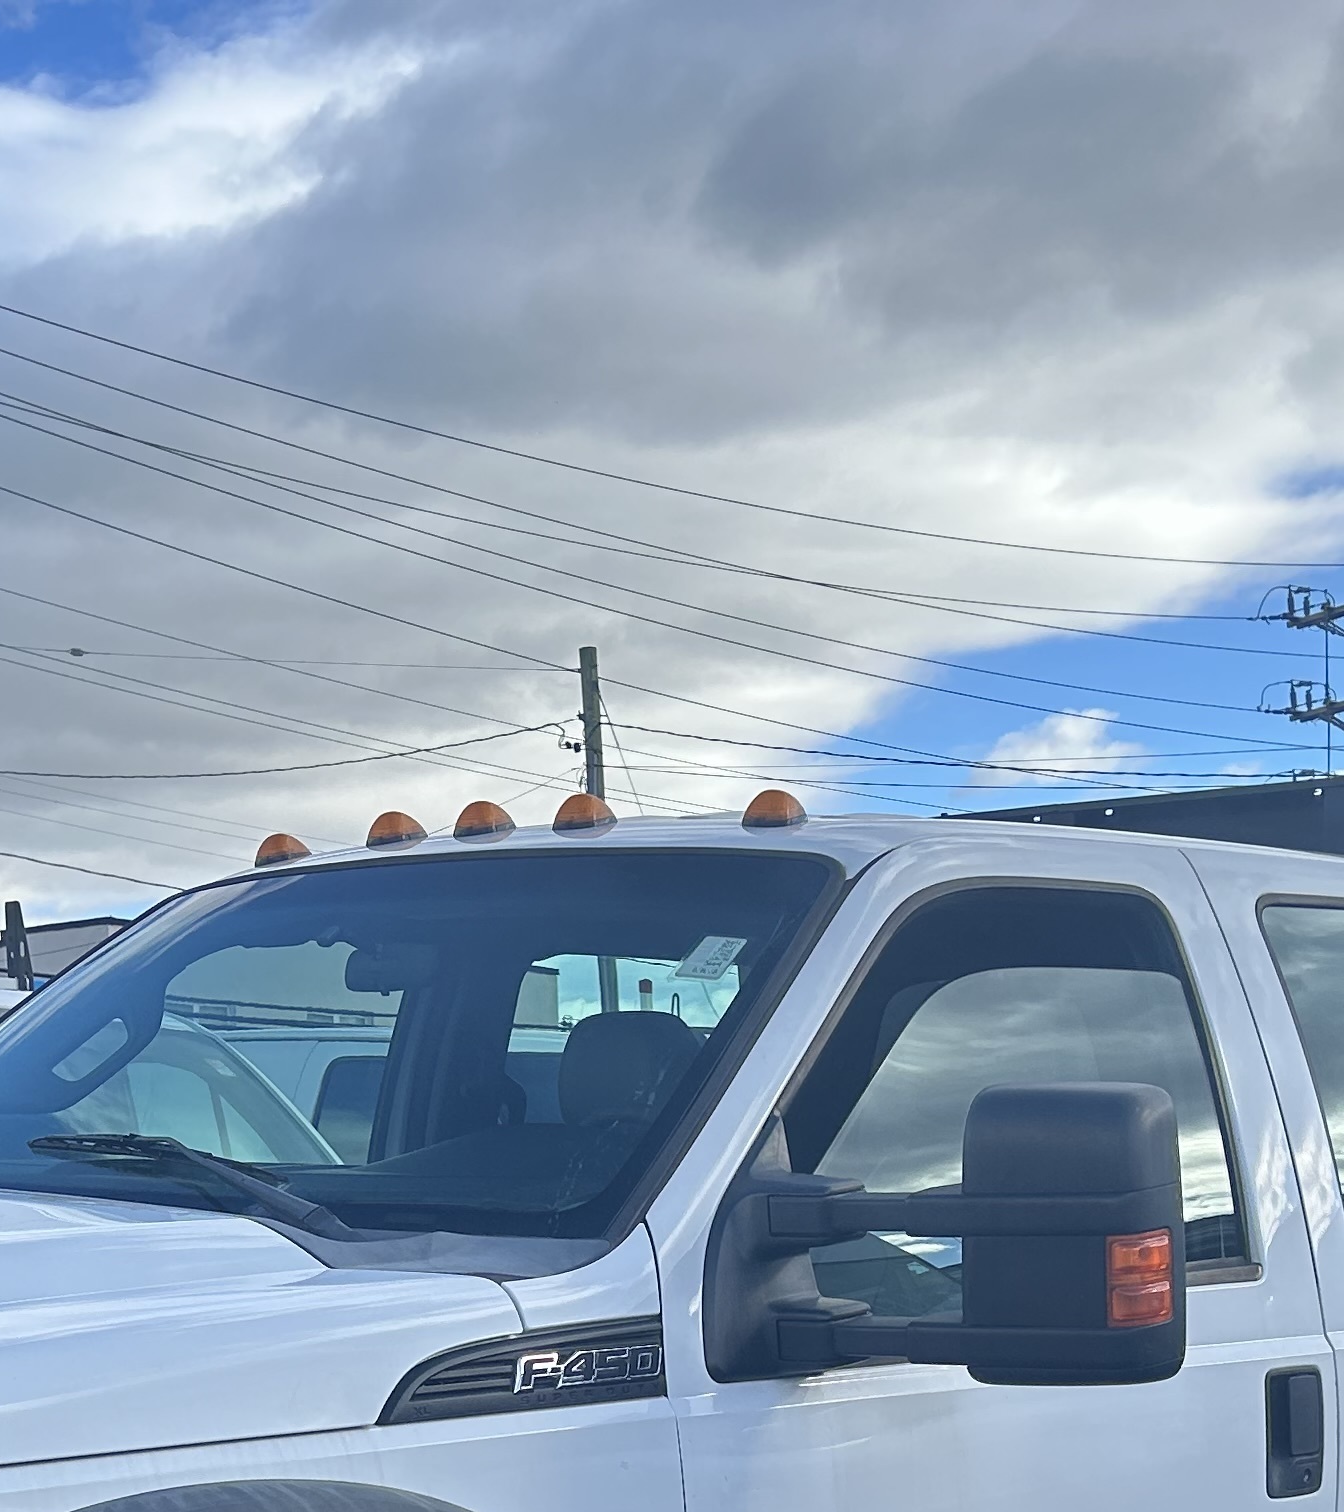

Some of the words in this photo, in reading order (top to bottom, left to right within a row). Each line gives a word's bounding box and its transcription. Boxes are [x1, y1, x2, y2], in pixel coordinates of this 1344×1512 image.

[513, 1343, 663, 1395] F-450
[520, 1390, 593, 1405] SUPER
[606, 1383, 660, 1398] DUTY
